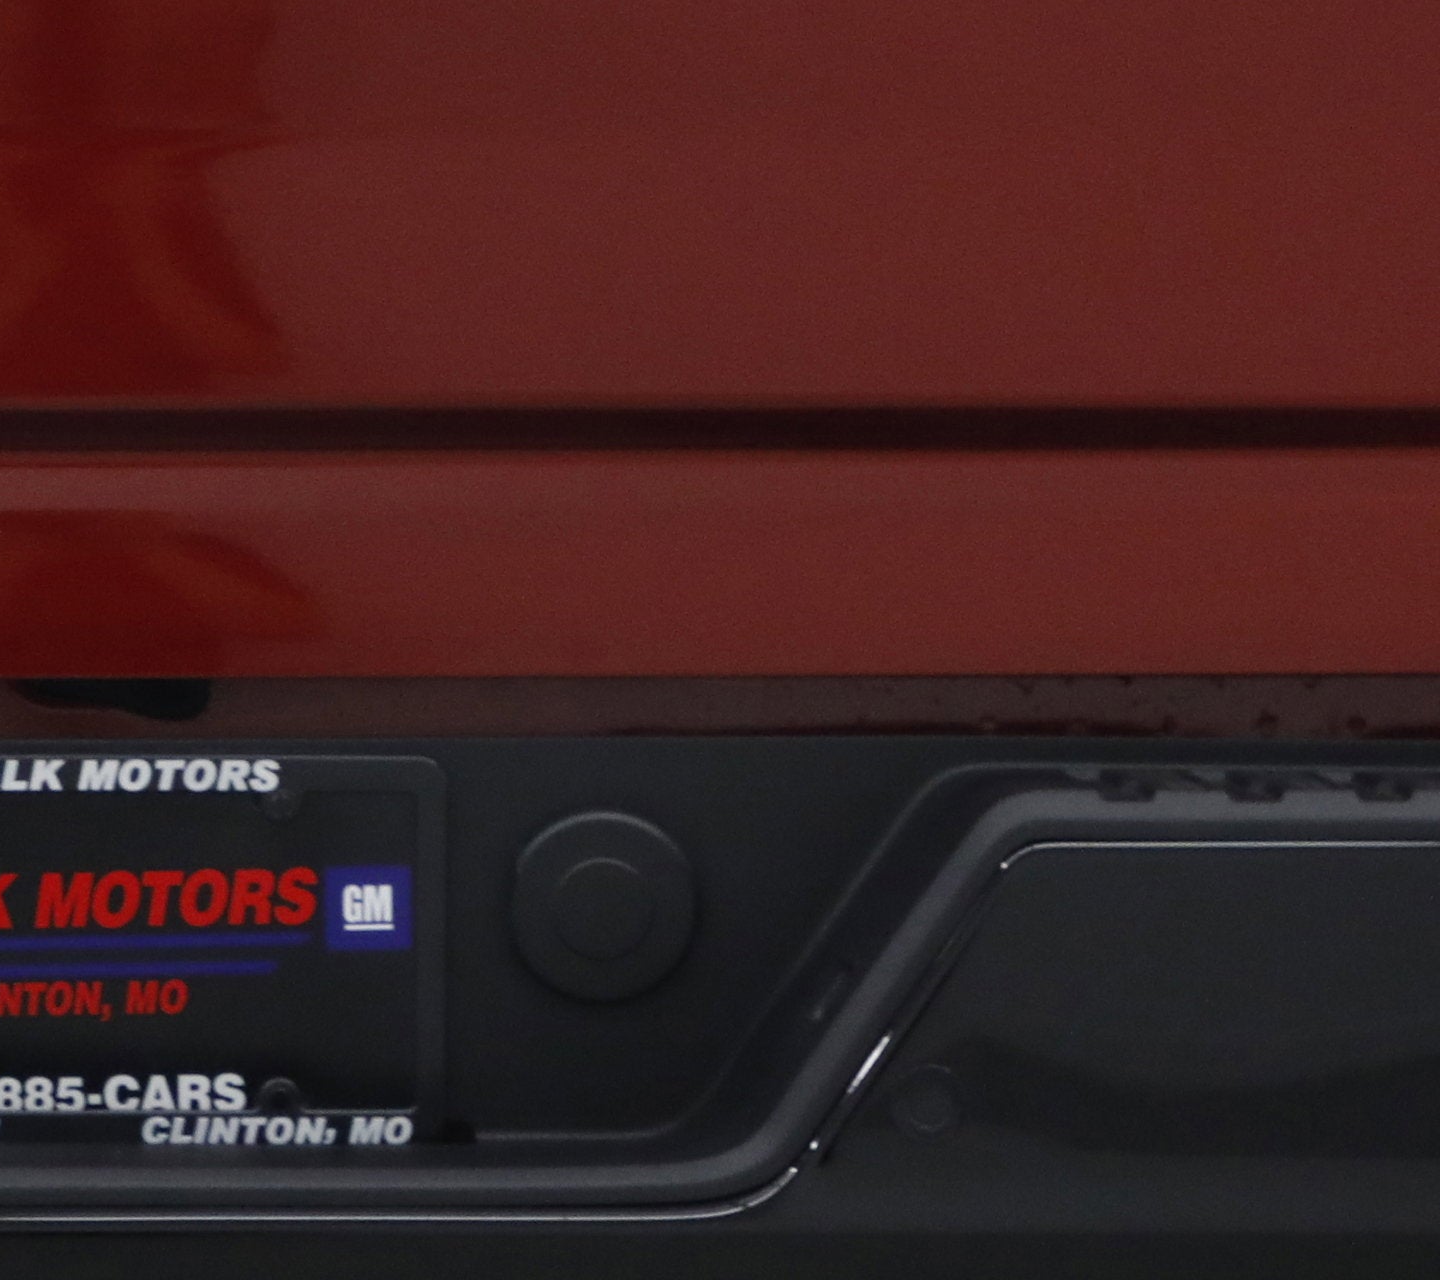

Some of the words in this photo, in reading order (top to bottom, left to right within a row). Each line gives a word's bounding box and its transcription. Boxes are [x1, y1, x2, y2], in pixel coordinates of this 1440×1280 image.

[77, 758, 281, 793] MOTORS
[34, 866, 319, 929] MOTORS
[342, 883, 394, 925] GM
[124, 978, 189, 1016] MO
[140, 1116, 338, 1146] CLINTON,
[348, 1116, 414, 1145] MO
